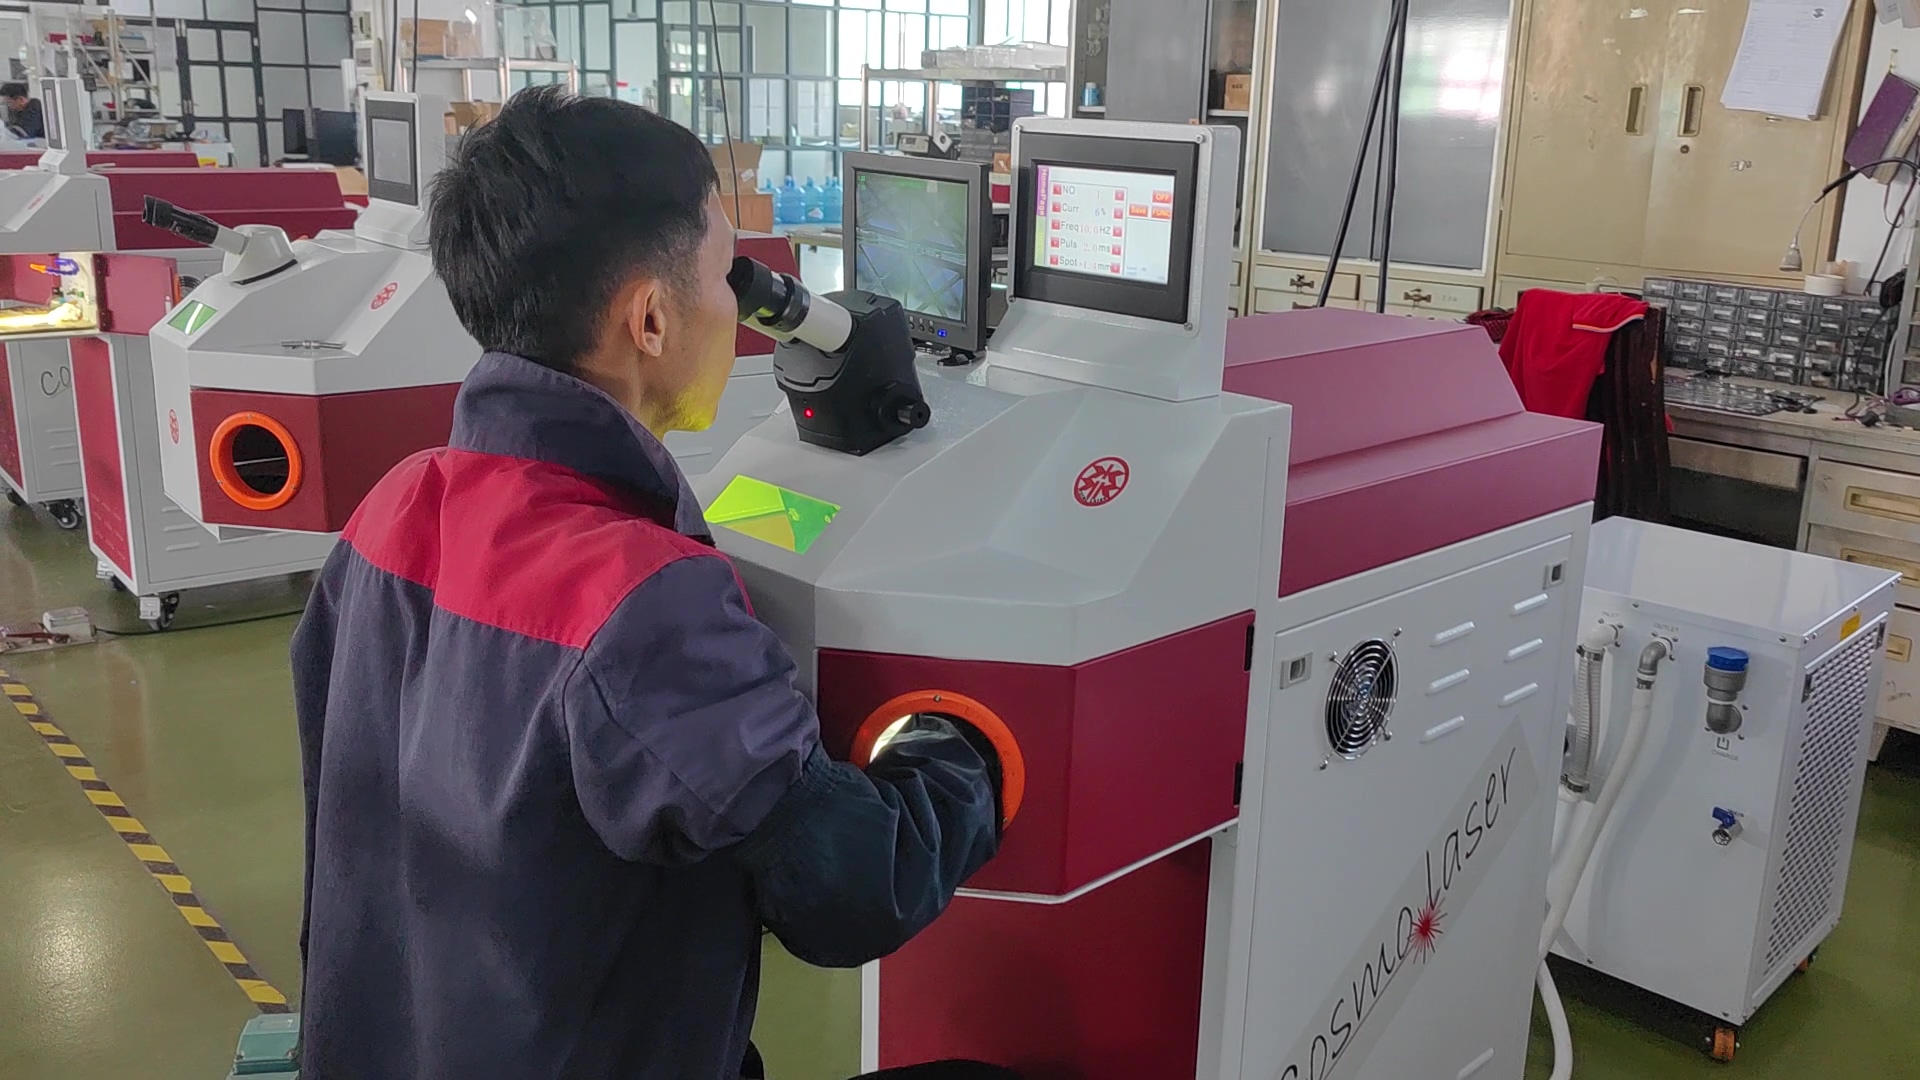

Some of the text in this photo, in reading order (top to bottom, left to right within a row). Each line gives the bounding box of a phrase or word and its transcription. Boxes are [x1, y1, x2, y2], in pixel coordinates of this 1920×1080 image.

[1062, 185, 1076, 195] NO
[1155, 193, 1170, 201] OFF
[1061, 202, 1080, 213] Curr
[1130, 205, 1147, 214] Save
[1060, 220, 1079, 233] Freq
[1060, 238, 1078, 249] Puls
[1059, 255, 1078, 267] Spot
